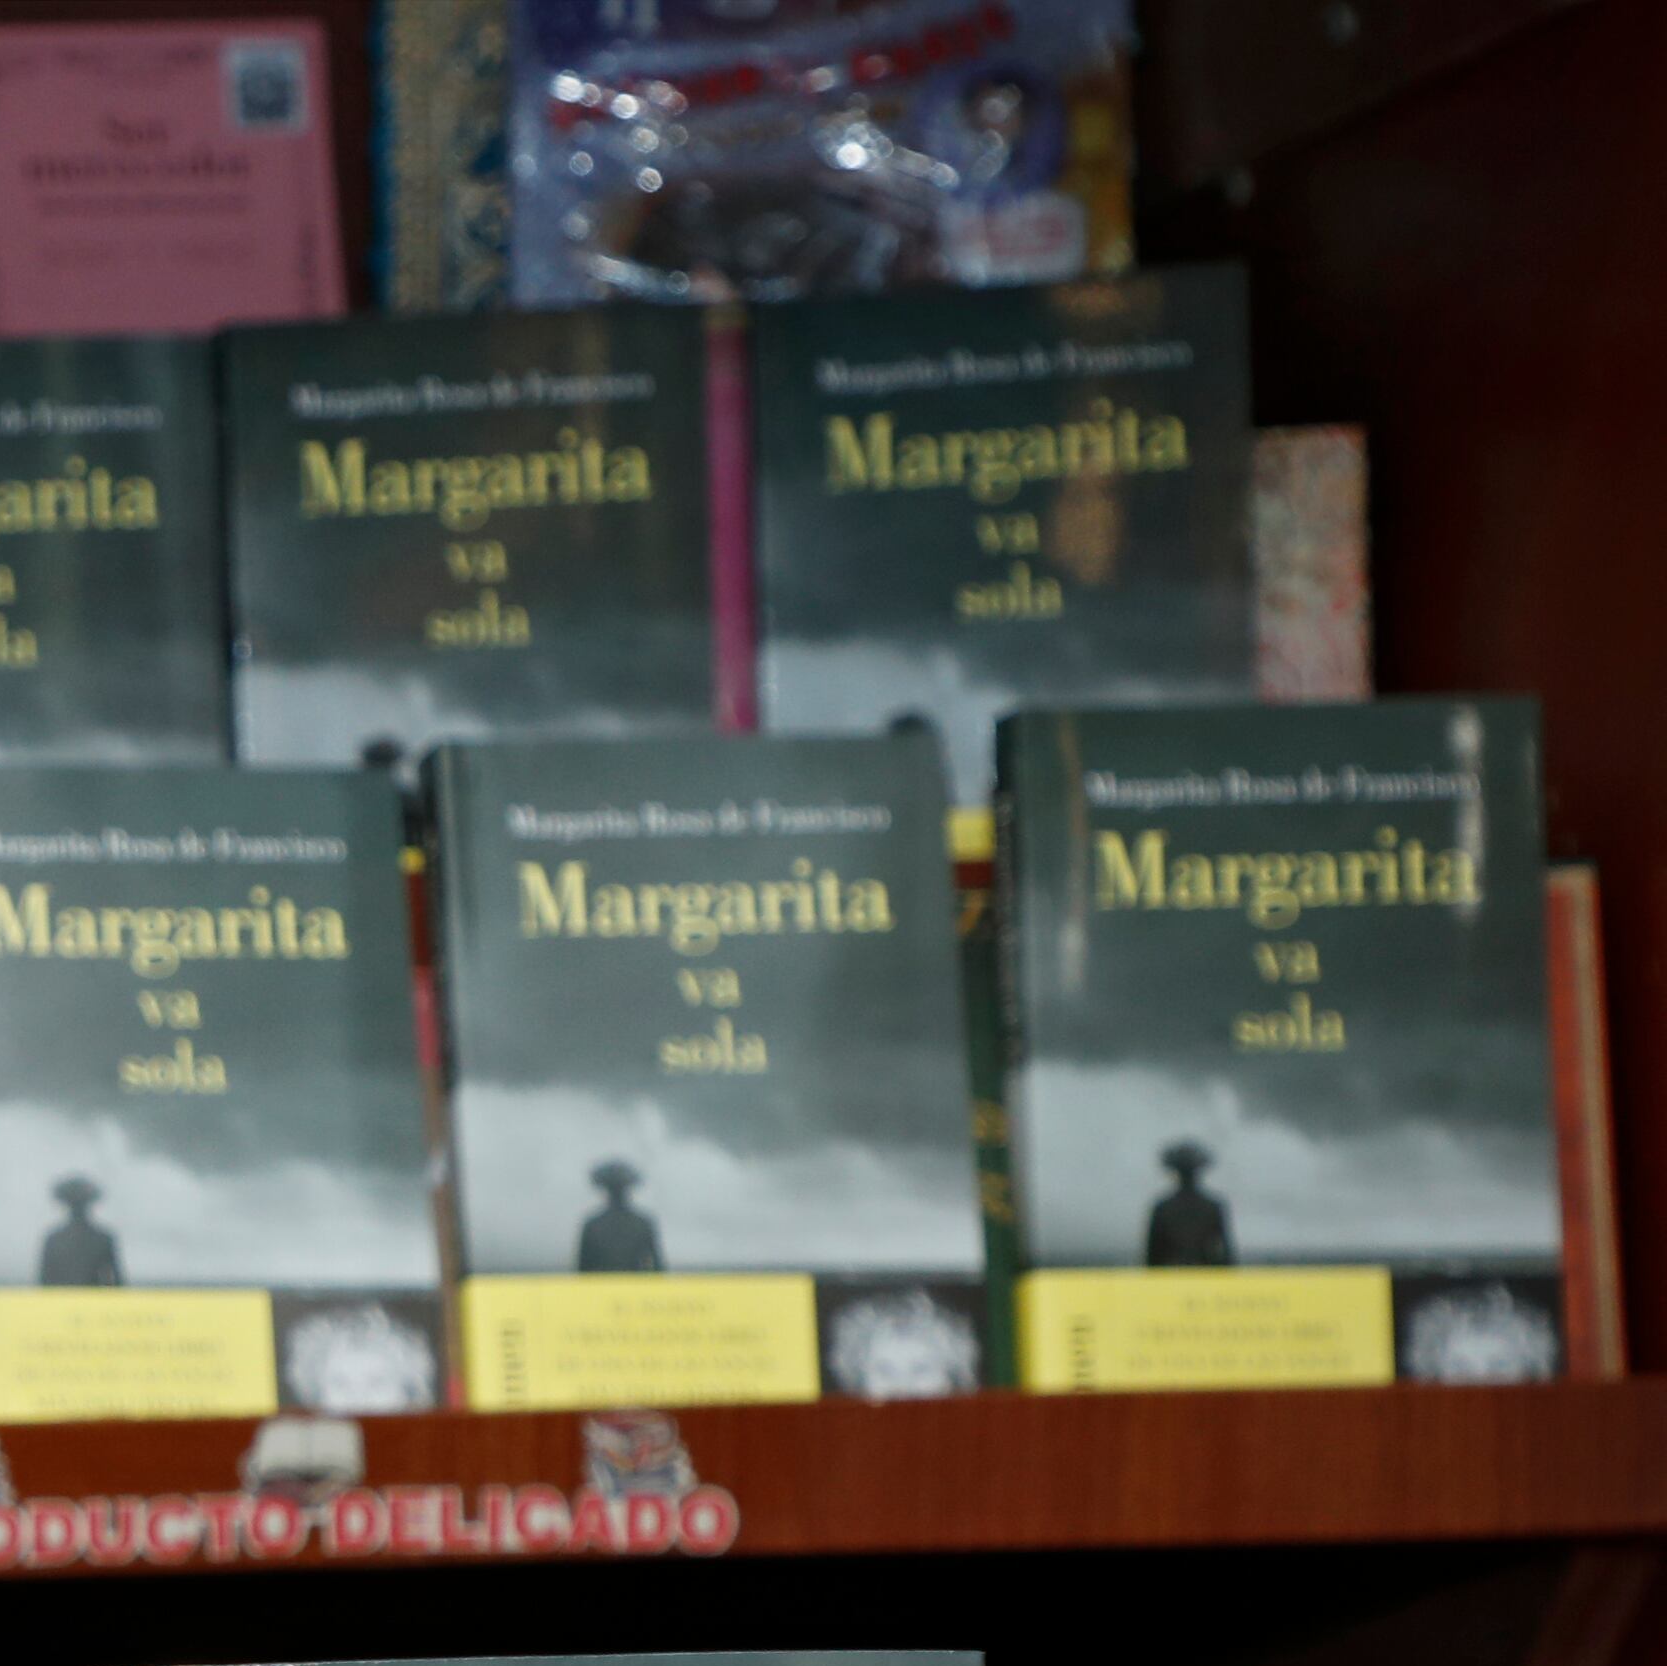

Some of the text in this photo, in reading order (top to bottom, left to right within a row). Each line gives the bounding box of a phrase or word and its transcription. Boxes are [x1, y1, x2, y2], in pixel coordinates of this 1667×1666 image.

[299, 425, 652, 533] Margarita
[822, 397, 1188, 505] Margarita
[517, 857, 895, 956] Margarita
[1094, 826, 1482, 930] Margarita
[677, 966, 744, 1008] va
[1253, 939, 1321, 984] va
[138, 989, 203, 1031] va
[1231, 992, 1346, 1053] sola
[119, 1036, 228, 1096] sola
[659, 1016, 768, 1075] sola
[321, 1482, 740, 1558] DELICADO
